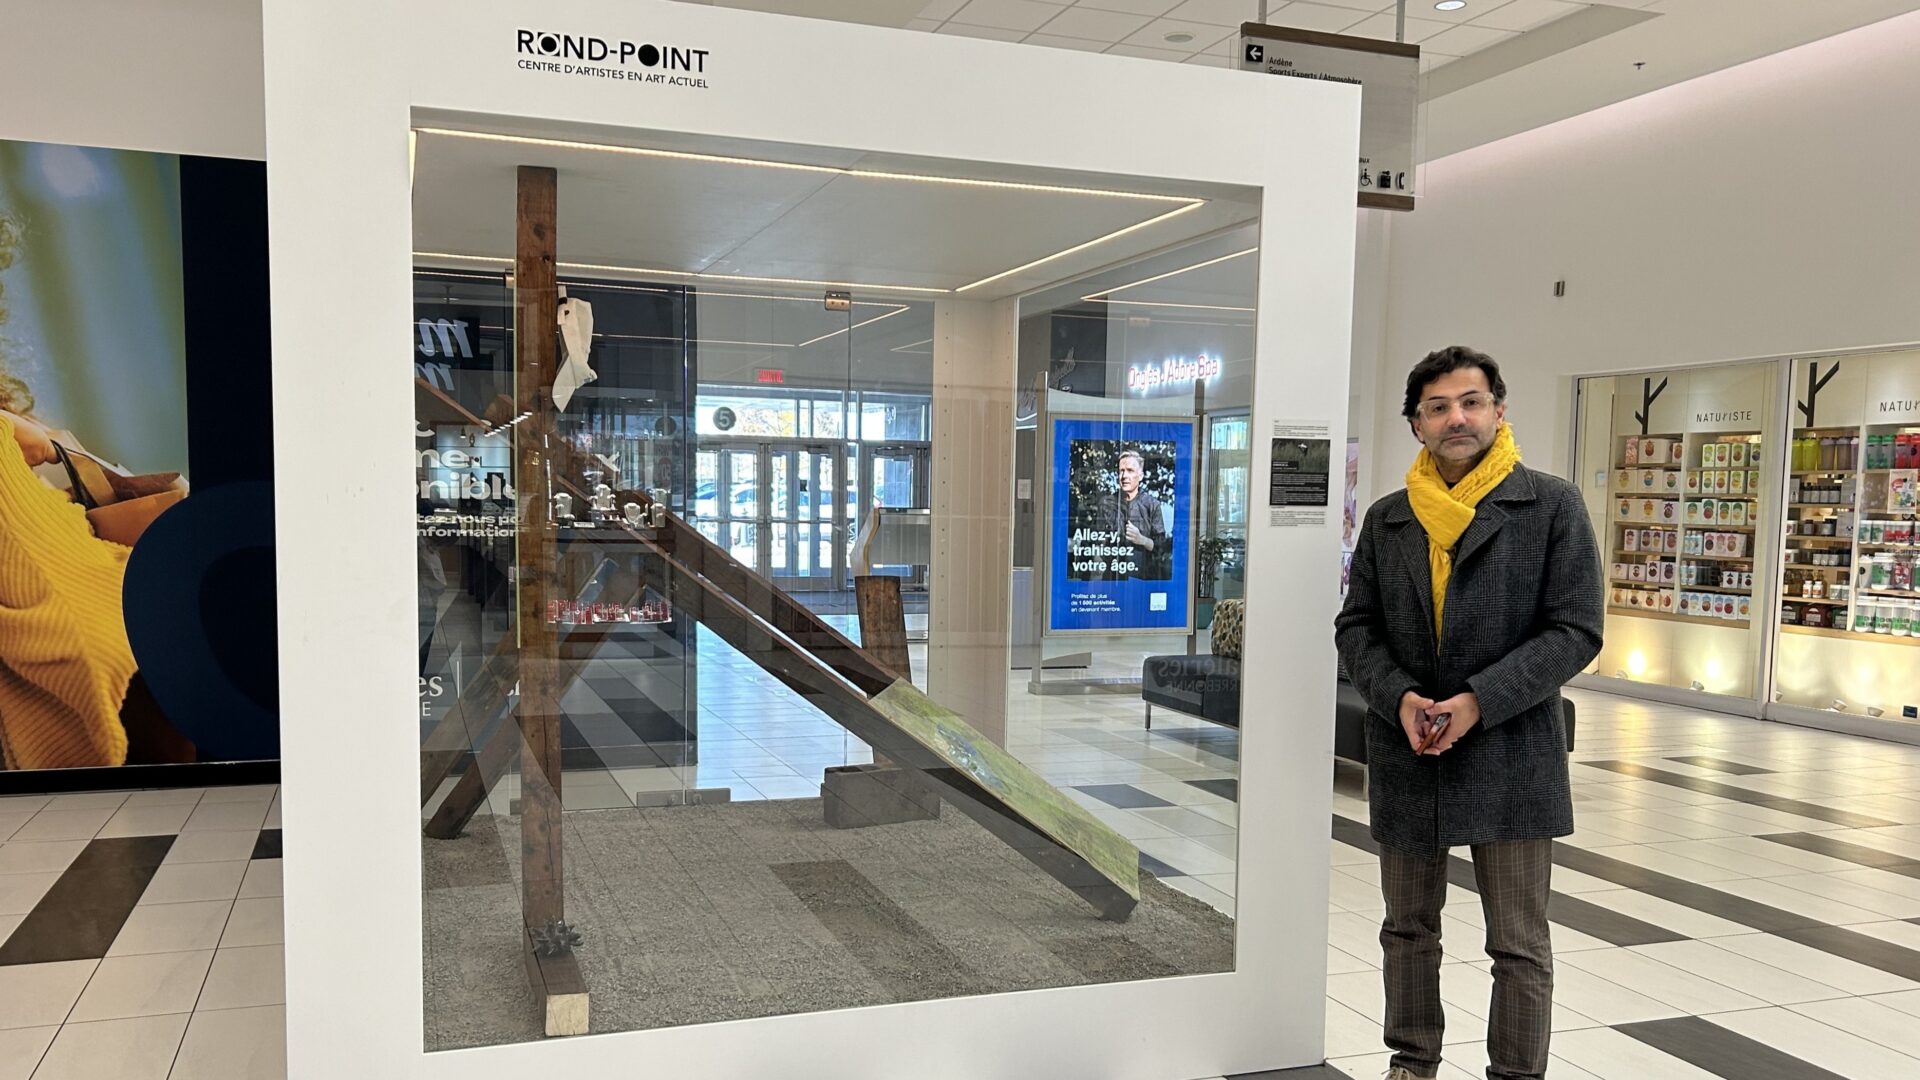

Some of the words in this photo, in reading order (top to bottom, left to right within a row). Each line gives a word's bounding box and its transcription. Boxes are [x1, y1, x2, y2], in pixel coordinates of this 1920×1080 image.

[517, 30, 709, 73] ROND-POINT
[1269, 57, 1293, 67] Ardène
[518, 60, 561, 73] CENTRE
[564, 65, 624, 80] D'ARTISTES
[628, 72, 642, 82] EN
[646, 74, 666, 85] ART
[669, 77, 709, 89] ACTUEL
[718, 410, 730, 427] 5
[1073, 528, 1120, 543] Allez-y,
[1073, 544, 1134, 556] trahissez
[1072, 560, 1107, 572] votre
[1110, 557, 1138, 574] âge.
